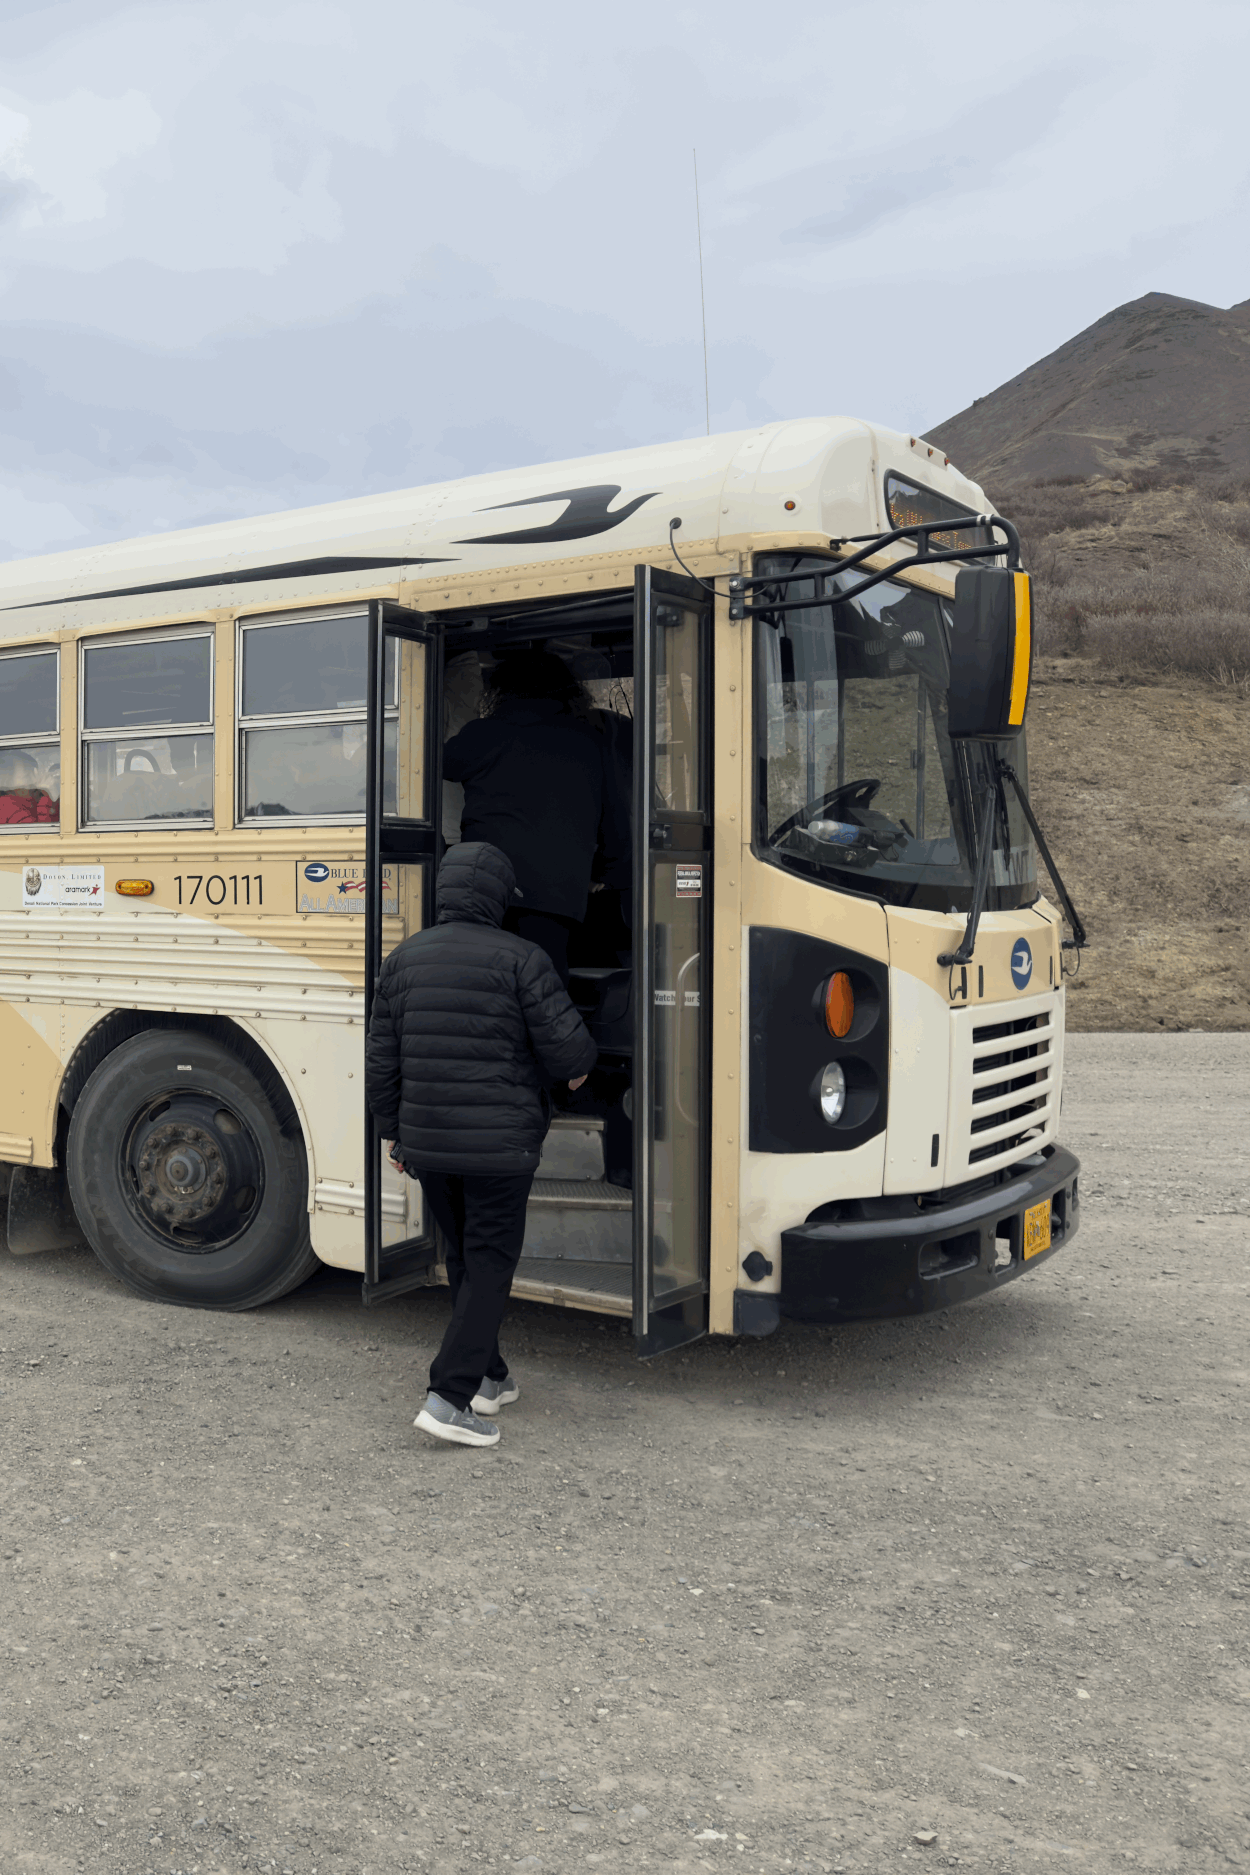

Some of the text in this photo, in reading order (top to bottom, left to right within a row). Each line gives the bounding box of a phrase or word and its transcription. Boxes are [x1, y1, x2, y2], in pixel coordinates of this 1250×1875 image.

[330, 868, 359, 879] BLUE
[64, 885, 91, 893] aramark
[173, 874, 263, 905] 170111
[298, 893, 398, 914] ALL AMERAN
